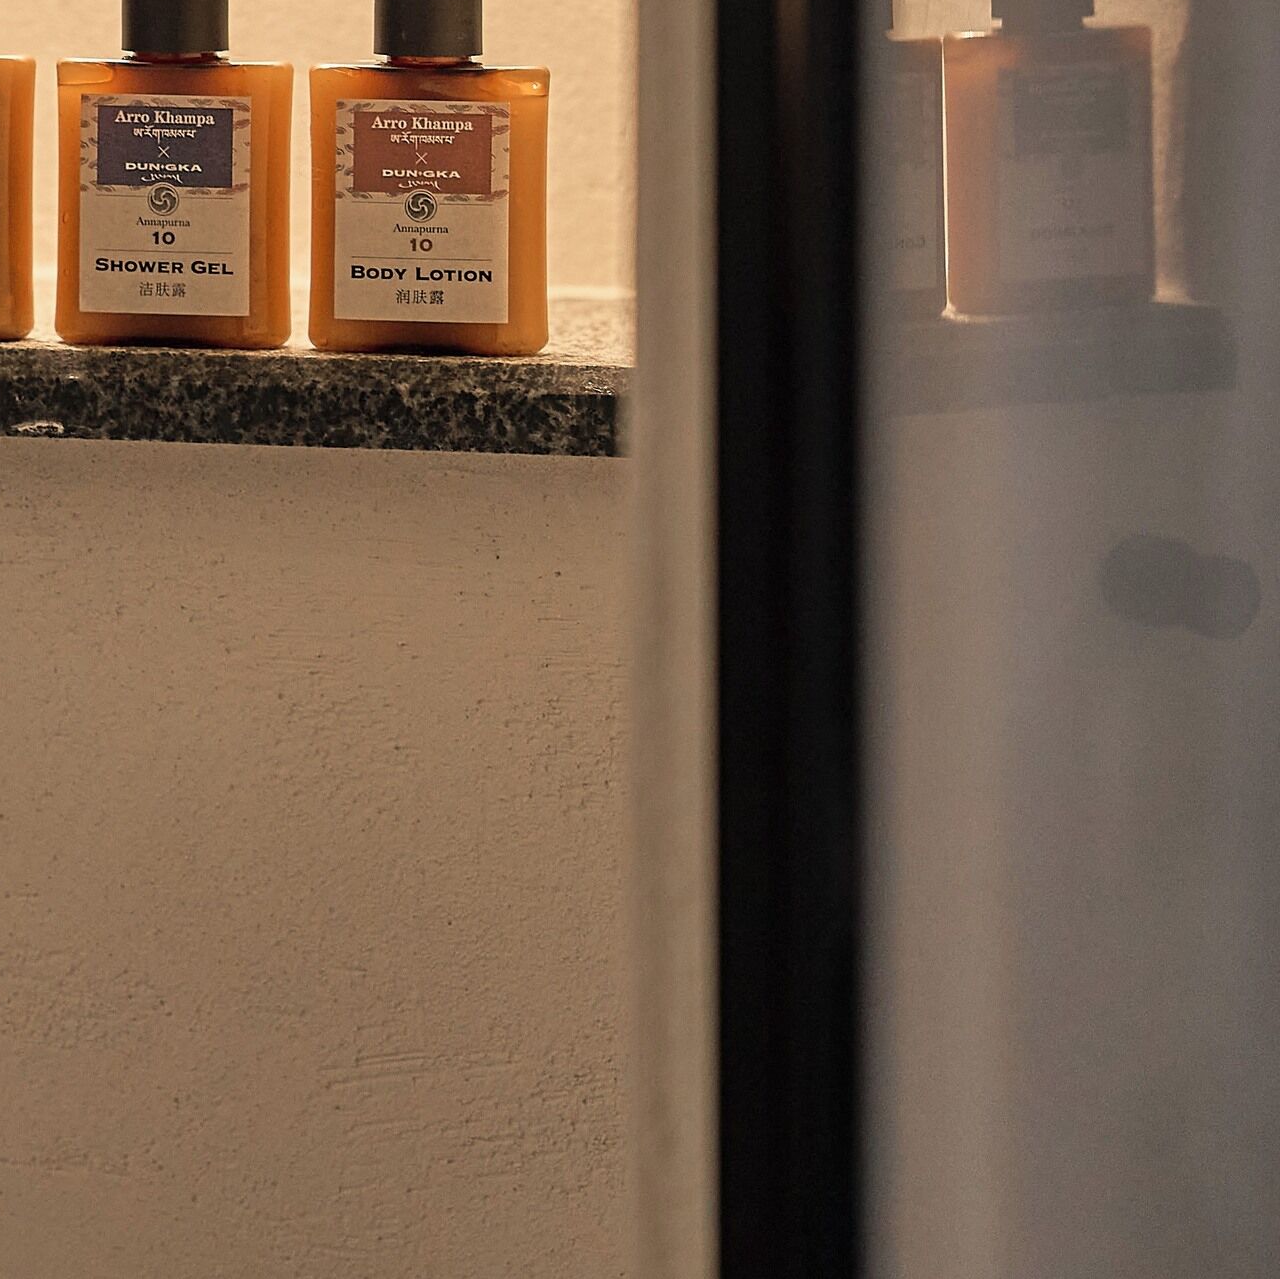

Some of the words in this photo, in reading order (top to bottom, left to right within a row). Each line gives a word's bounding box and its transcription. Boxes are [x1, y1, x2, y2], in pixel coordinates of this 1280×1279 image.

[115, 110, 149, 123] Arro
[153, 111, 215, 127] Khampa
[371, 116, 407, 129] Arro
[411, 117, 473, 132] Khampa
[136, 216, 190, 229] Annapurna
[393, 223, 449, 236] Annapurna
[152, 231, 175, 245] 10
[410, 238, 433, 252] 10
[95, 258, 184, 274] SHOWER
[191, 261, 234, 275] GEL
[351, 265, 407, 280] BODY
[416, 267, 492, 282] LOTION
[139, 282, 186, 298] 洁肤露
[396, 289, 444, 305] 润肤露
